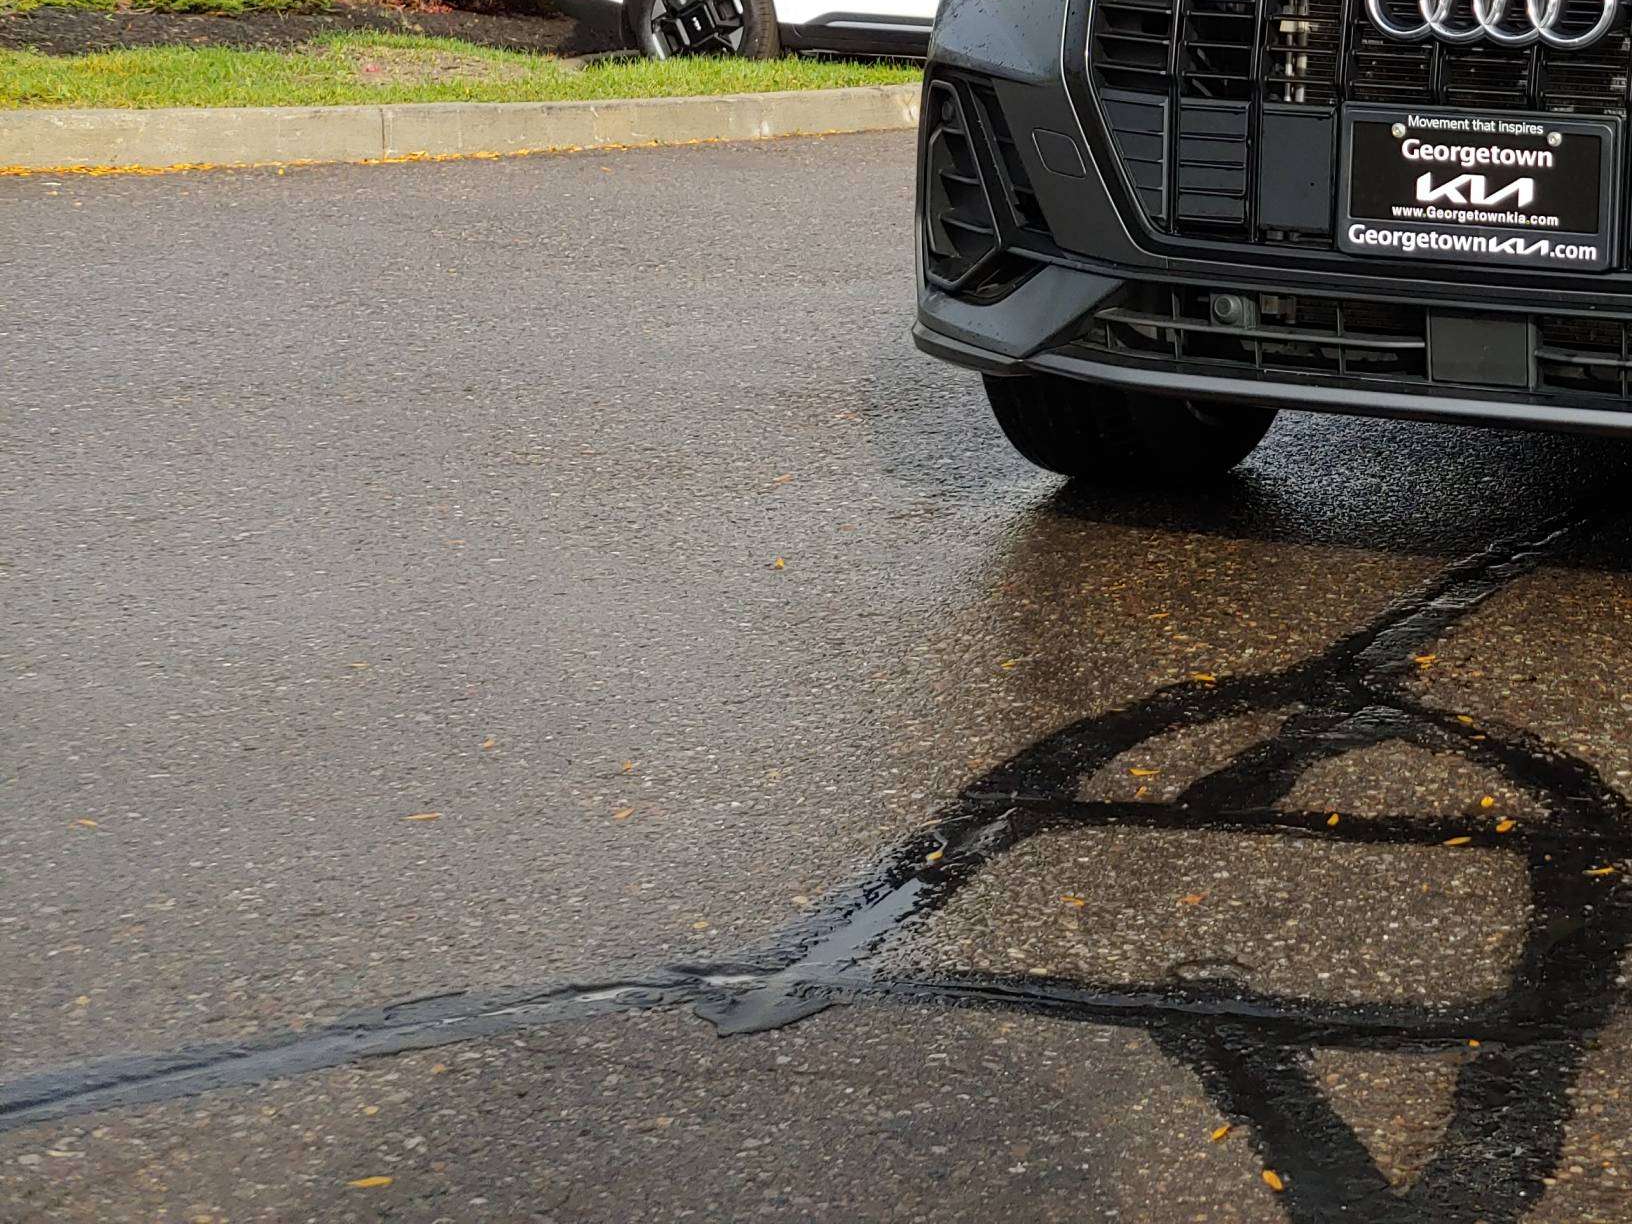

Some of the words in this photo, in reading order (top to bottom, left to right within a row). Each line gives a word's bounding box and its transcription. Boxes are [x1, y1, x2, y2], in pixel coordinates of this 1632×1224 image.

[1407, 114, 1470, 130] Movement
[1472, 119, 1496, 132] that
[1401, 138, 1554, 168] Georgetown
[1416, 172, 1535, 208] KIA
[1391, 205, 1560, 227] www.Georgetownkia.com
